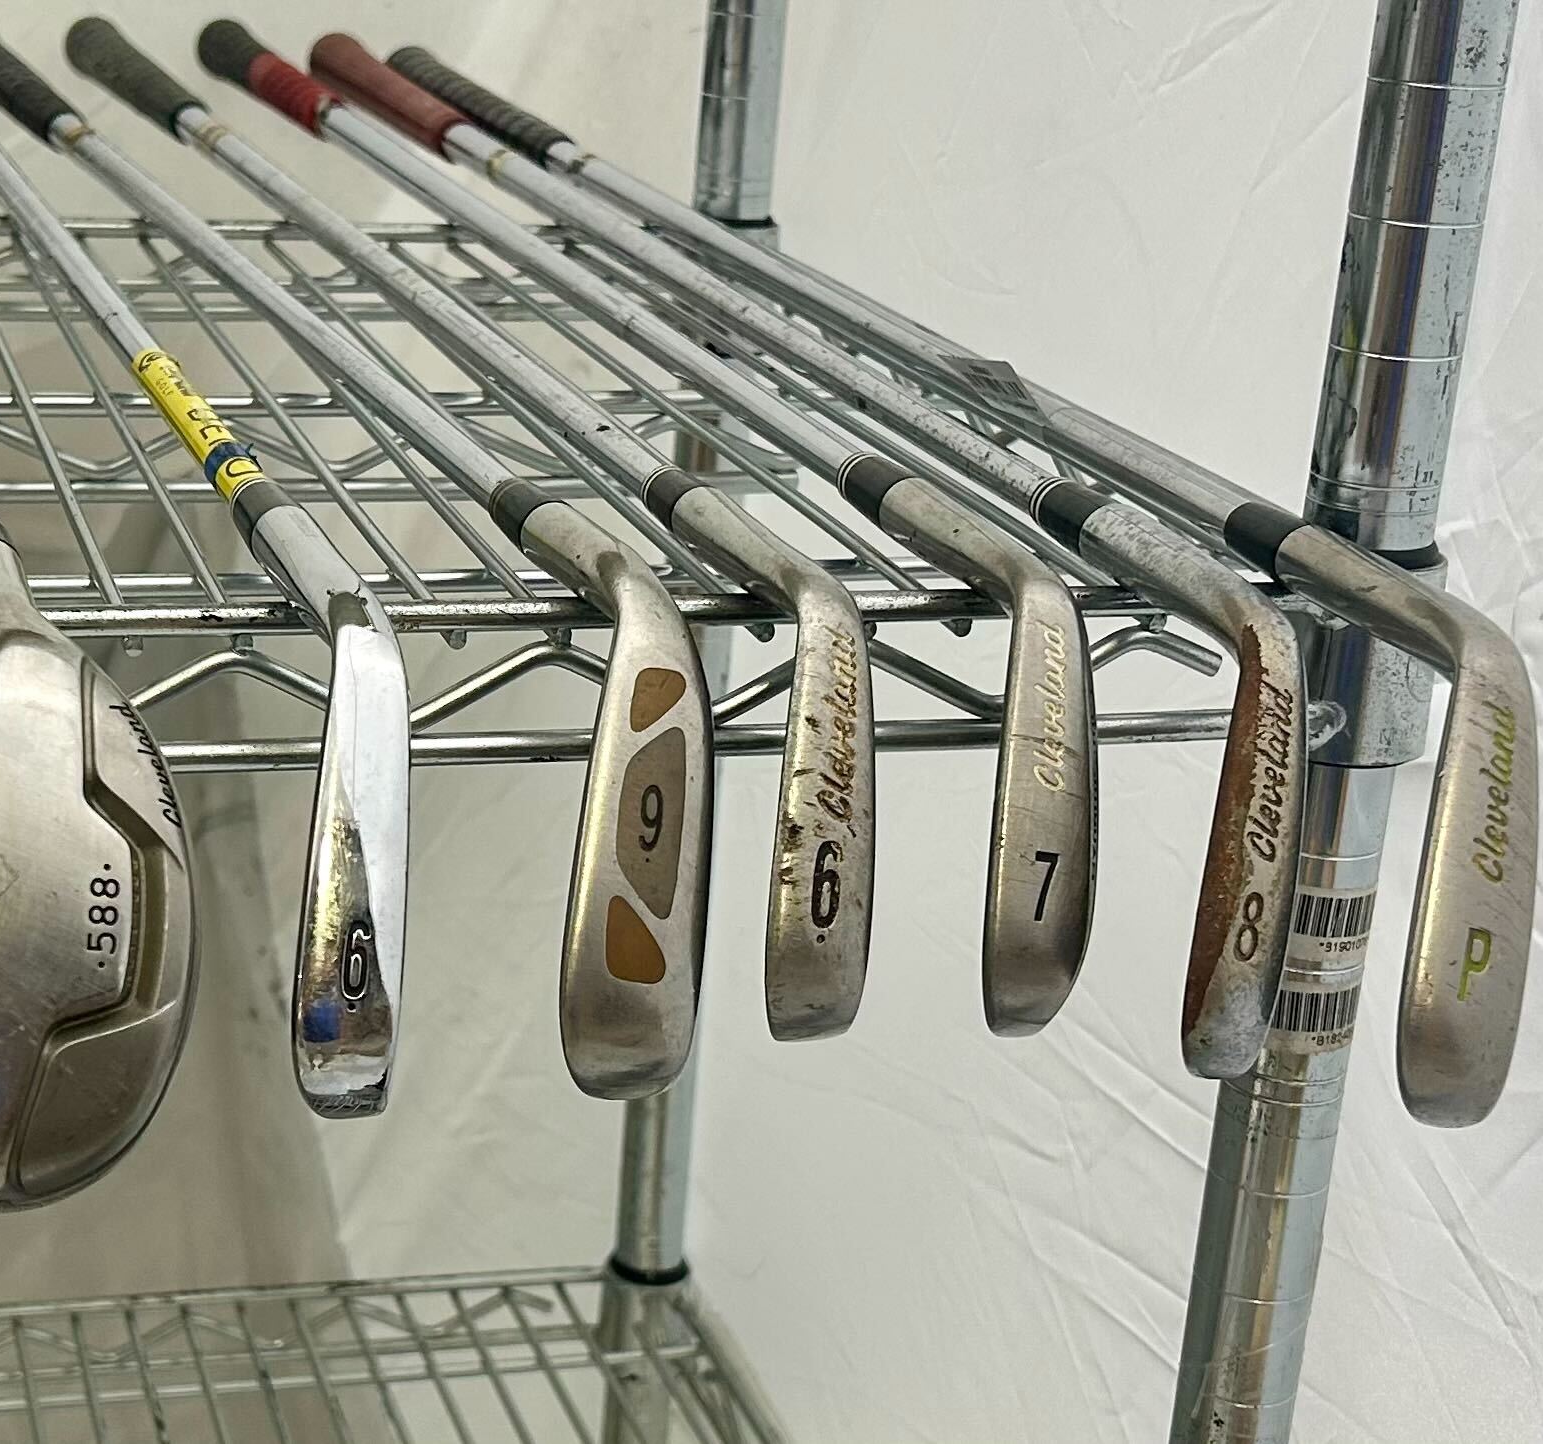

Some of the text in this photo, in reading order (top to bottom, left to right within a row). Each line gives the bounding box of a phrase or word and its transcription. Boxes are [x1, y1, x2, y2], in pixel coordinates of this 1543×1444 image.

[817, 626, 856, 823] Cleveland
[1034, 619, 1067, 793] Cleveland
[108, 700, 183, 829] Cleveland
[1246, 673, 1295, 863] Cleveland
[1473, 702, 1516, 884] Cleveland
[810, 839, 844, 929] 6
[1033, 850, 1062, 922] 7
[1233, 891, 1265, 963] 8
[341, 920, 372, 1001] 6
[1457, 926, 1491, 1001] P
